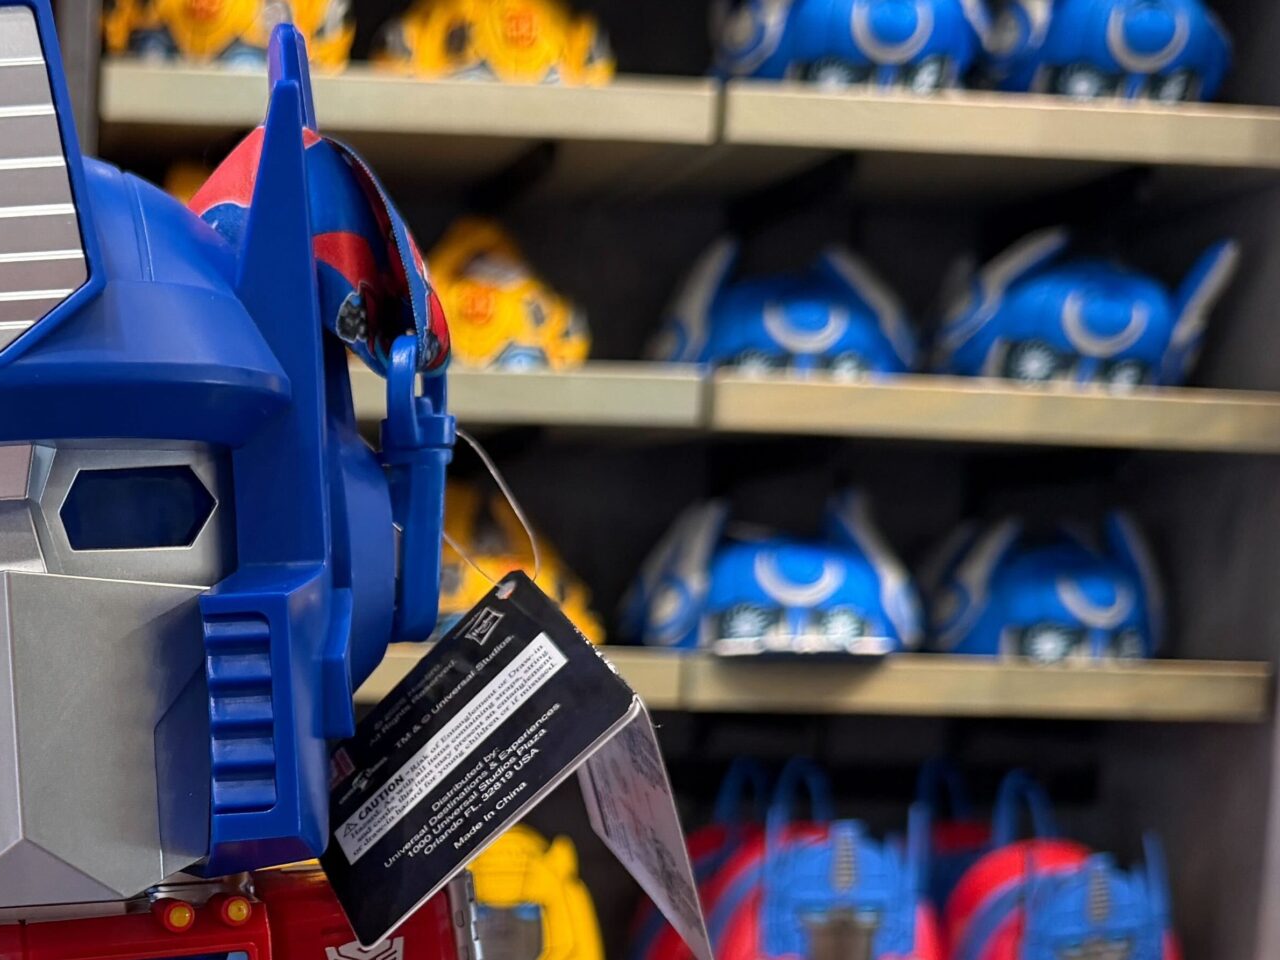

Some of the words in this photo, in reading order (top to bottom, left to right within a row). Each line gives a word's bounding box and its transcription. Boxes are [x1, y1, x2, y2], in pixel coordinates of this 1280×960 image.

[356, 825, 372, 843] and
[397, 786, 413, 804] this
[413, 768, 432, 788] item
[433, 749, 453, 770] may
[452, 719, 485, 752] present
[483, 708, 496, 721] an
[495, 654, 553, 711] entanglement
[357, 773, 404, 822] CAUTION
[428, 741, 440, 754] of
[439, 687, 497, 745] Entanglement
[496, 678, 507, 689] or
[507, 642, 544, 678] Draw-in
[380, 701, 411, 734] Rights
[382, 794, 395, 808] As
[394, 776, 414, 796] with
[413, 764, 426, 778] all
[426, 741, 450, 765] items
[449, 699, 495, 745] containing
[521, 648, 549, 675] string
[394, 730, 412, 750] TM
[410, 721, 422, 734] &
[420, 712, 431, 725] ©
[430, 669, 475, 715] Universal
[474, 631, 515, 671] Studios.
[352, 845, 362, 856] or
[362, 813, 394, 846] draw-in
[394, 786, 423, 816] hazard
[423, 774, 437, 788] for
[437, 748, 465, 776] young
[463, 714, 500, 750] children
[499, 705, 510, 716] or
[510, 696, 519, 706] if
[383, 824, 429, 869] Universal
[427, 768, 488, 827] Destinations
[487, 759, 498, 771] &
[497, 700, 562, 762] Experiences
[406, 832, 432, 859] 1000
[431, 790, 478, 836] Universal
[477, 754, 517, 792] Studios
[515, 726, 547, 757] Plaza
[422, 815, 464, 856] Orlando
[480, 768, 514, 802] 32819
[513, 745, 540, 772] USA
[430, 760, 484, 812] Distributed
[482, 745, 501, 764] by:
[452, 819, 484, 850] Made
[482, 808, 495, 822] In
[494, 779, 528, 811] China
